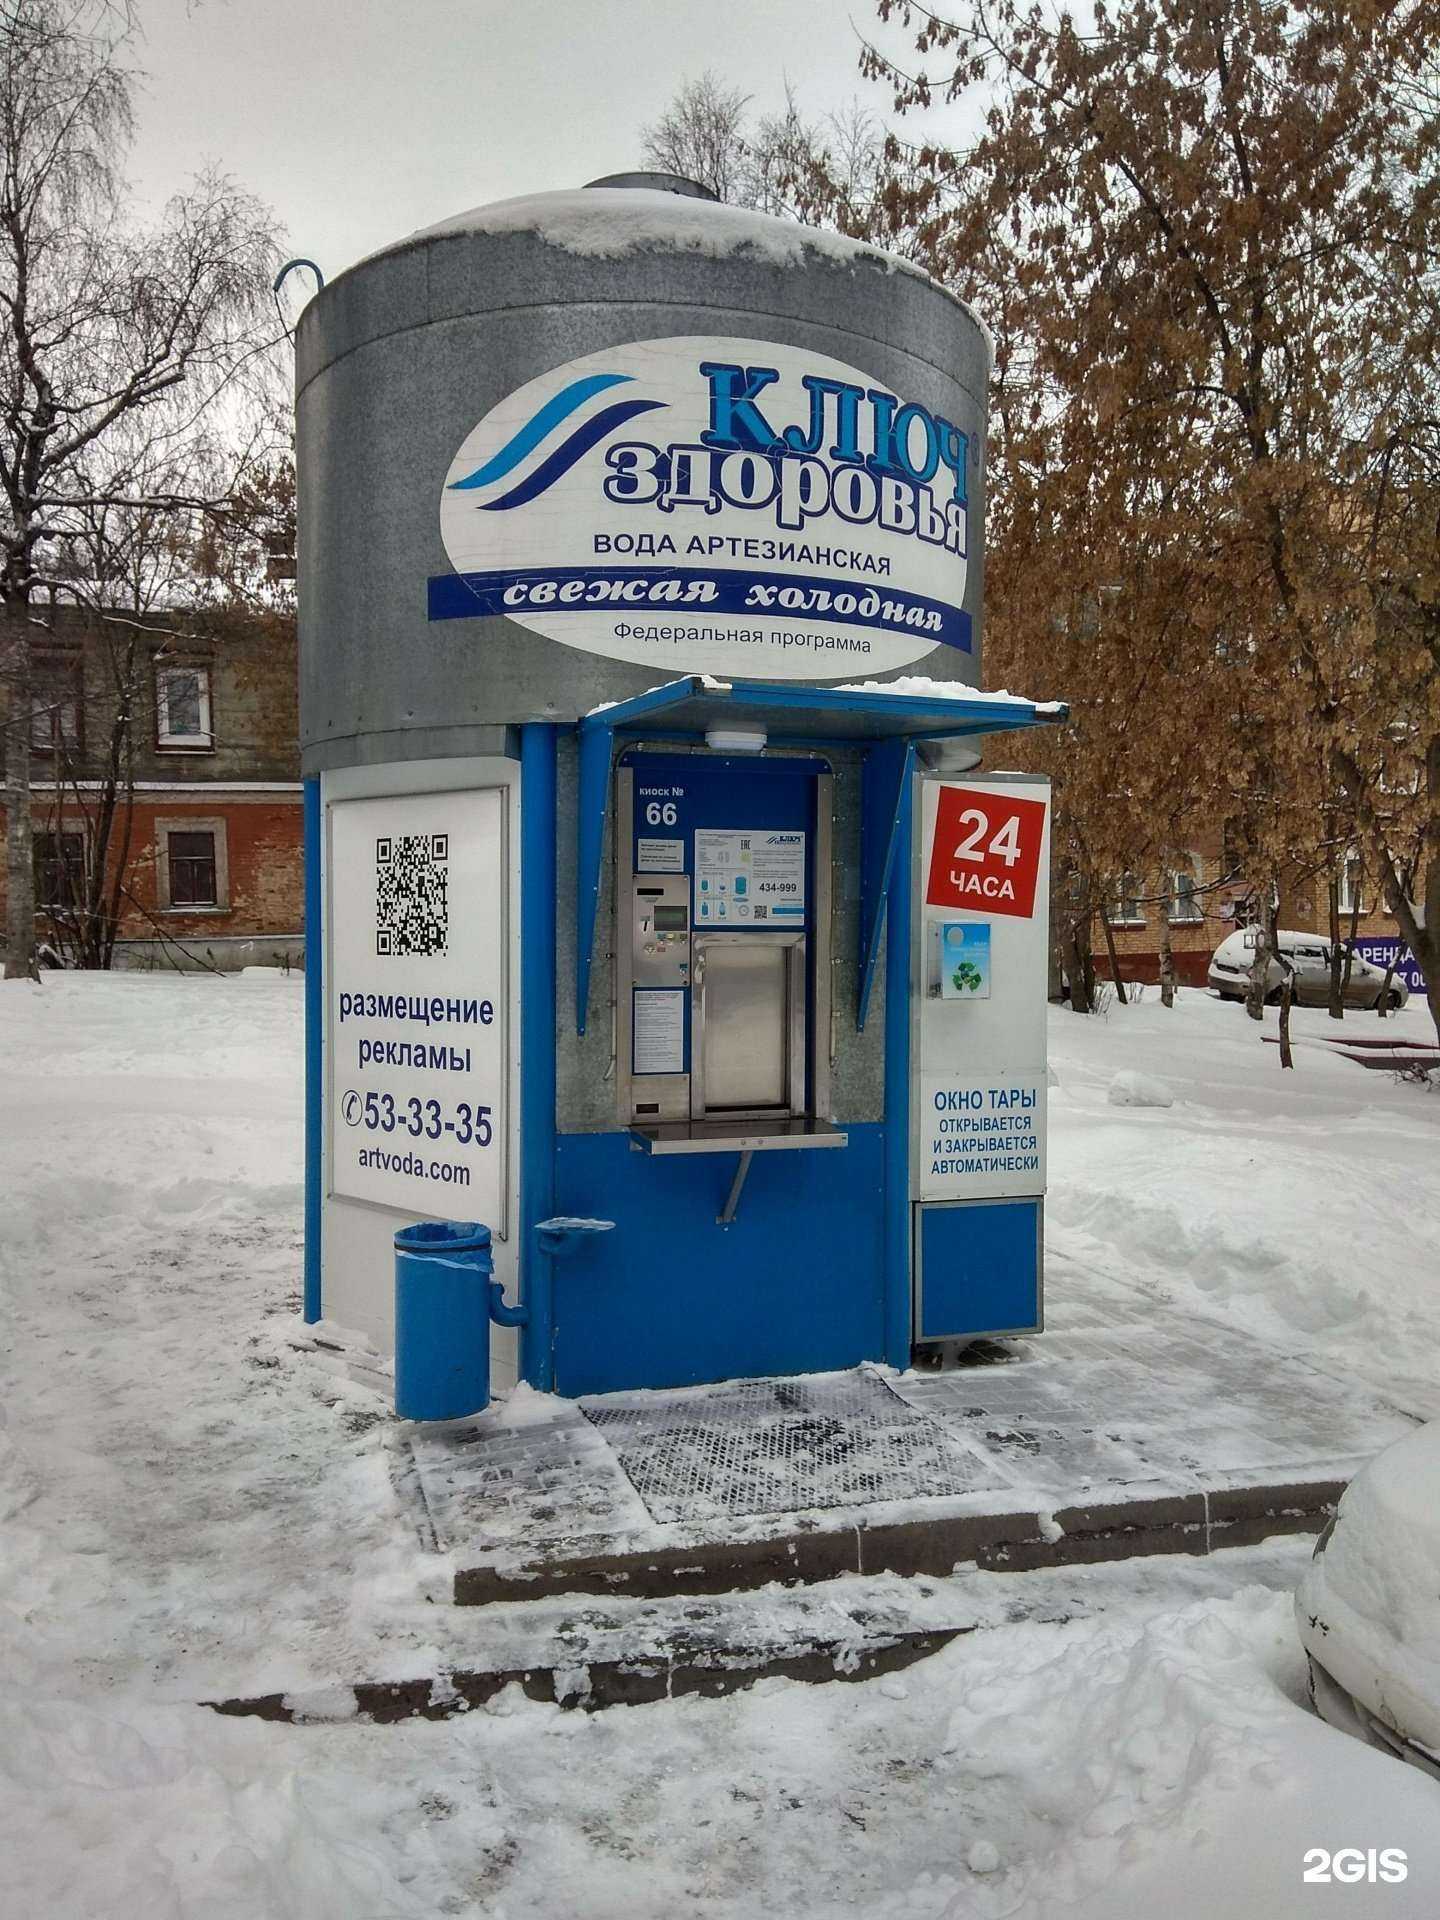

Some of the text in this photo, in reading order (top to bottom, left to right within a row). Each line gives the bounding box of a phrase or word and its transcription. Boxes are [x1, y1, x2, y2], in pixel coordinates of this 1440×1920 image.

[699, 361, 969, 503] КЛЮЧ
[593, 533, 891, 576] ВОДА АРТЕЗИАНСКАЯ
[502, 579, 944, 632] свежая холодная
[613, 622, 872, 654] Федеральная программа
[646, 802, 677, 826] 66
[953, 808, 1022, 867] 24
[759, 883, 797, 892] 434-999
[950, 870, 1015, 900] ЧАСА
[339, 991, 494, 1025] размещение
[358, 1037, 471, 1072] рекламы
[934, 1089, 1036, 1111] ОКНО ТАРЫ
[364, 1092, 493, 1147] 53-33-35
[939, 1116, 1032, 1133] ОТКРЫВАЕТСЯ
[933, 1135, 1037, 1153] И ЗАКРЫВАЕТСЯ
[358, 1146, 471, 1186] artvoda.com
[931, 1156, 1039, 1175] АВТОМАТИЧЕСКИ
